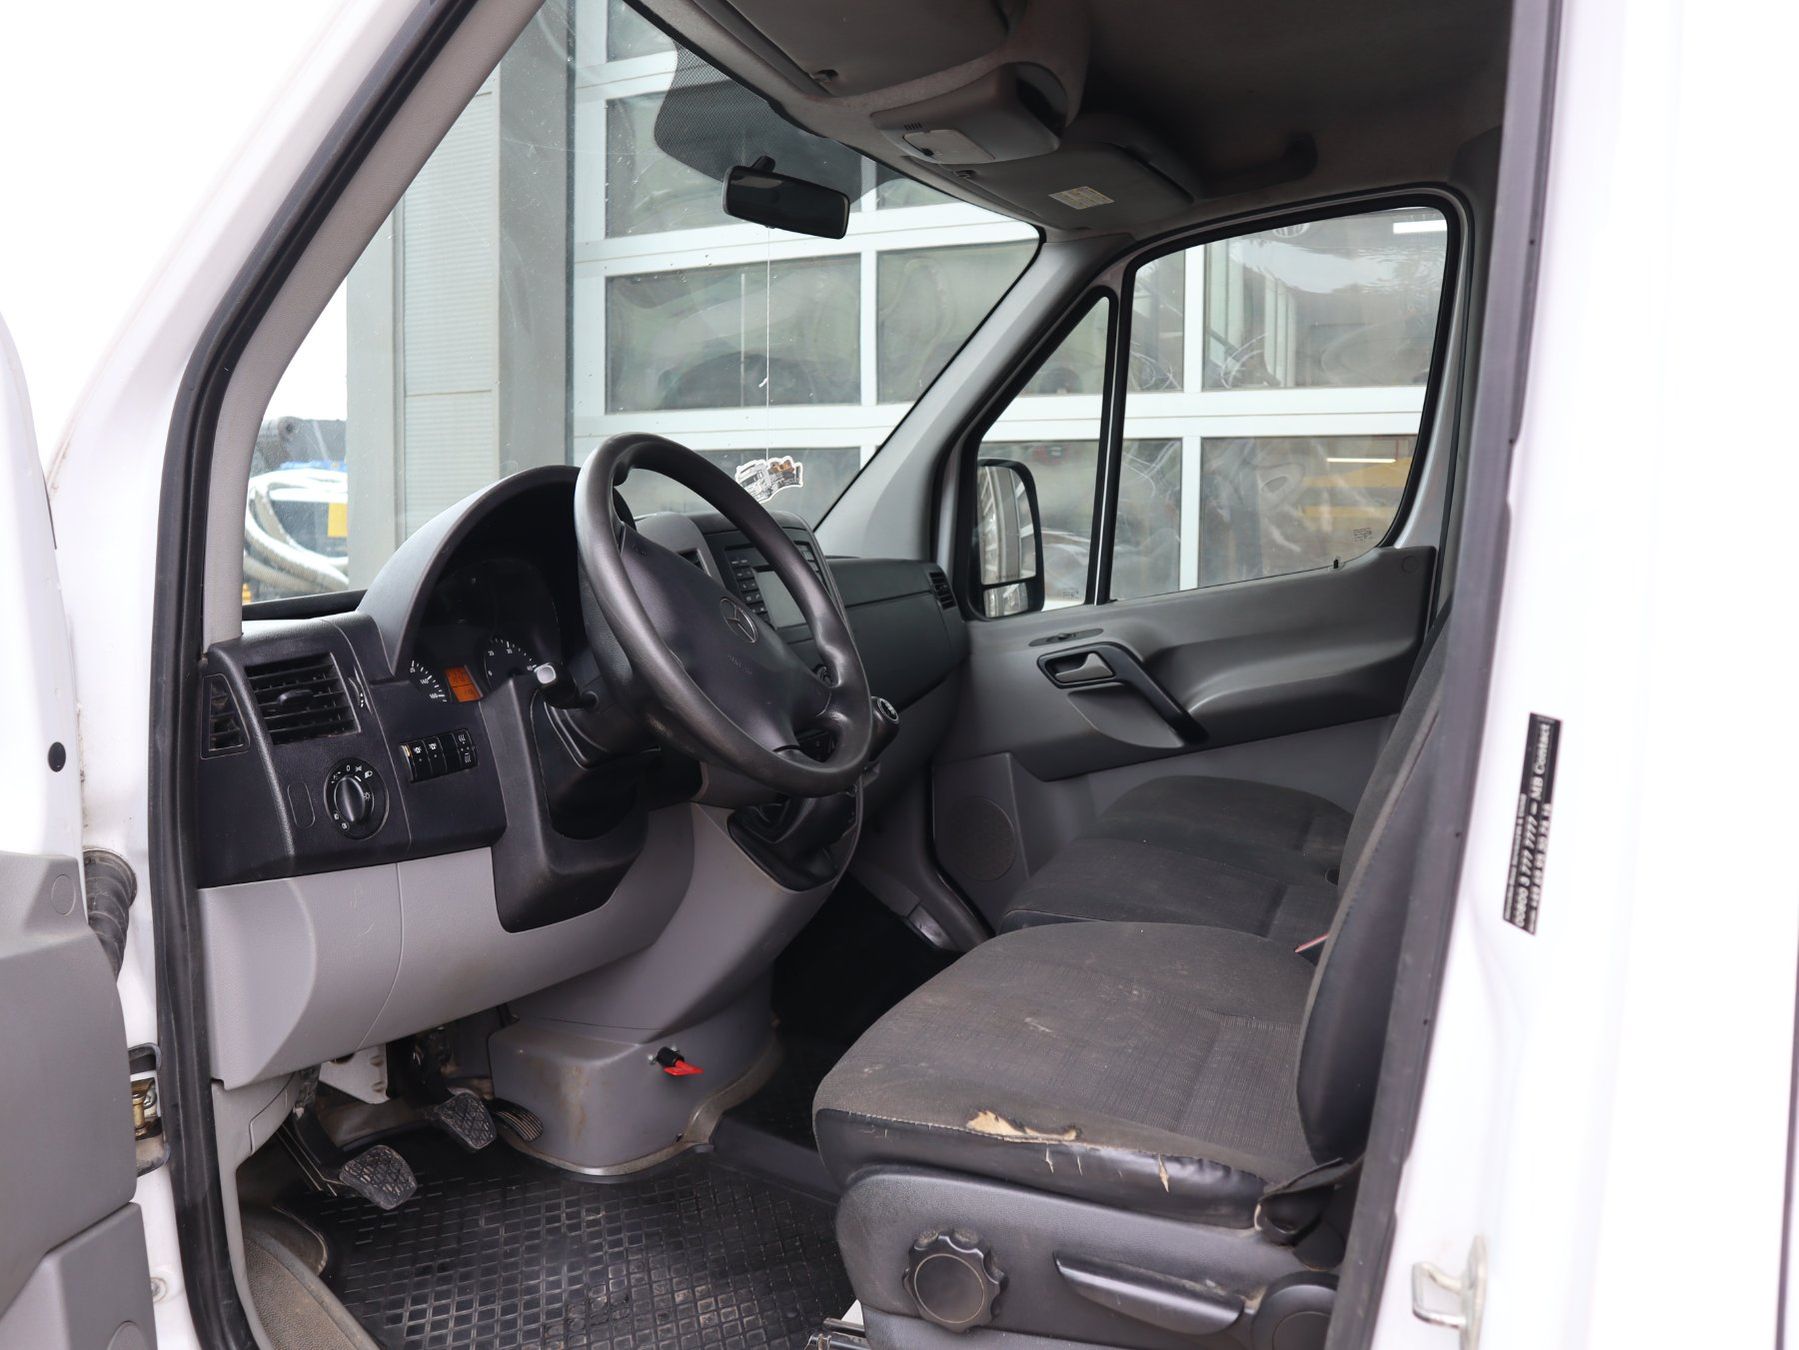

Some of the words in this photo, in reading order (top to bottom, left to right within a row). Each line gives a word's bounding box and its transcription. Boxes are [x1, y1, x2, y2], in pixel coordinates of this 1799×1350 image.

[1533, 723, 1550, 775] Contact
[1529, 776, 1543, 800] MB
[1524, 815, 1537, 847] 7777
[1520, 848, 1533, 873] 777
[1519, 874, 1530, 886] 3
[1514, 885, 1528, 927] 00800
